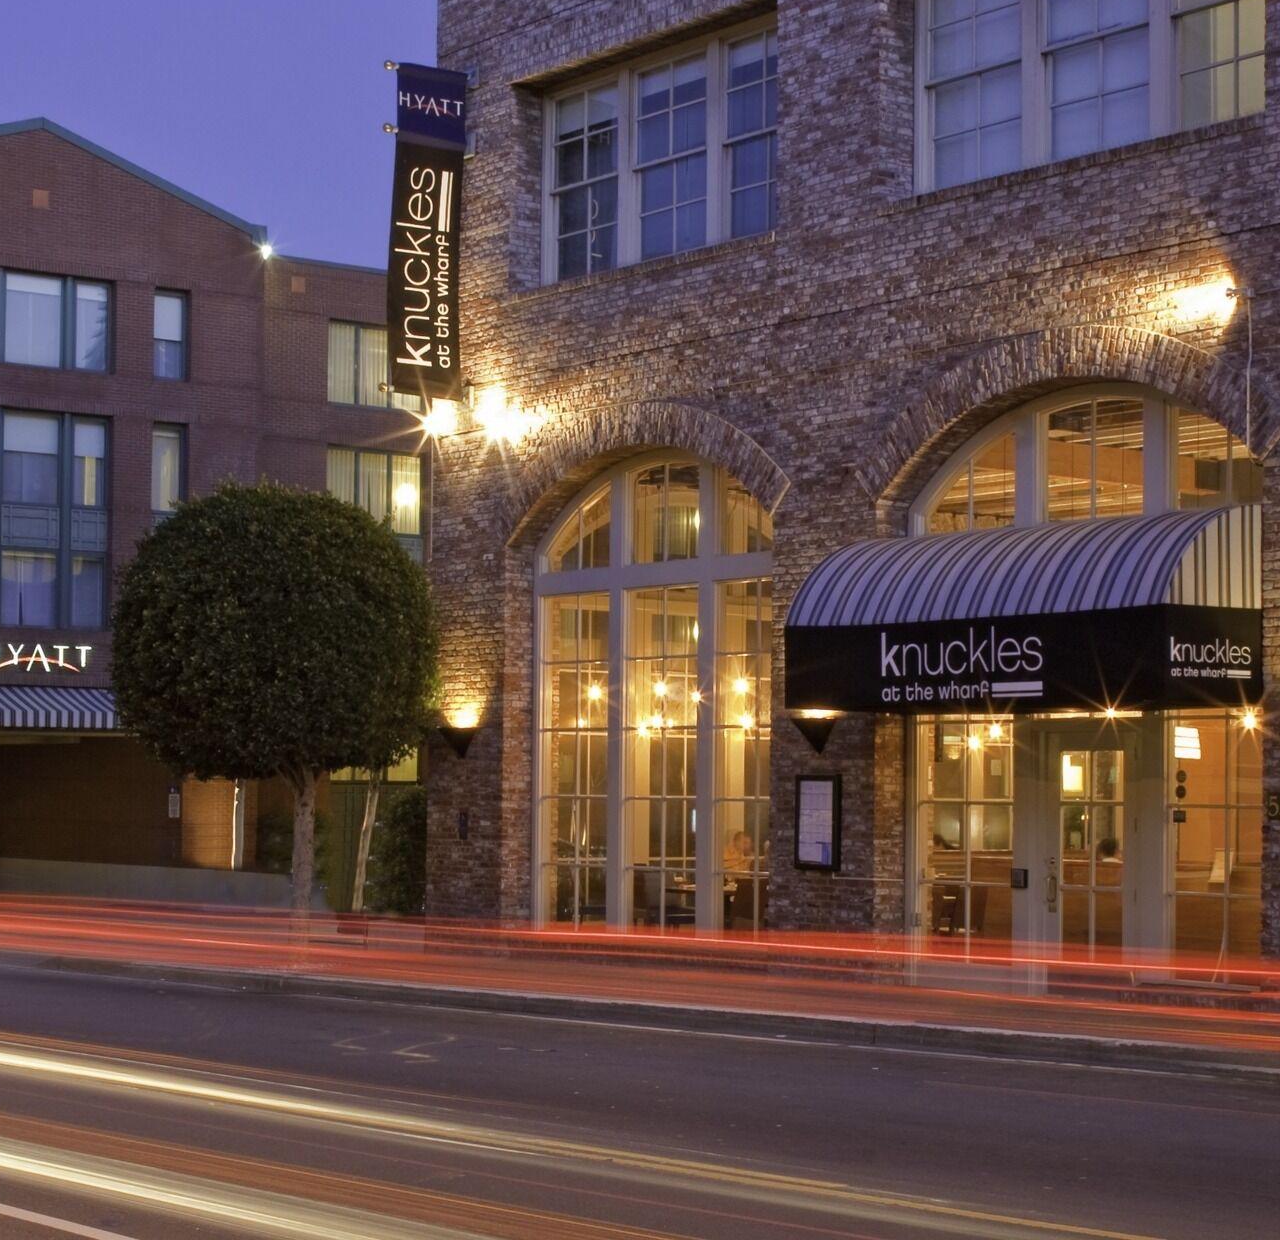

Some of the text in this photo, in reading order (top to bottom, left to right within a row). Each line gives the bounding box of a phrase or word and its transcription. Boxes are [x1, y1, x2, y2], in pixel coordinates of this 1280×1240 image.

[399, 90, 464, 117] HYATT
[394, 166, 436, 368] knuckles
[434, 233, 451, 369] at the wharf
[880, 625, 1044, 677] knuckles
[1170, 636, 1252, 664] knuckles
[1171, 666, 1227, 678] at the wharf
[881, 680, 989, 702] at the wharf
